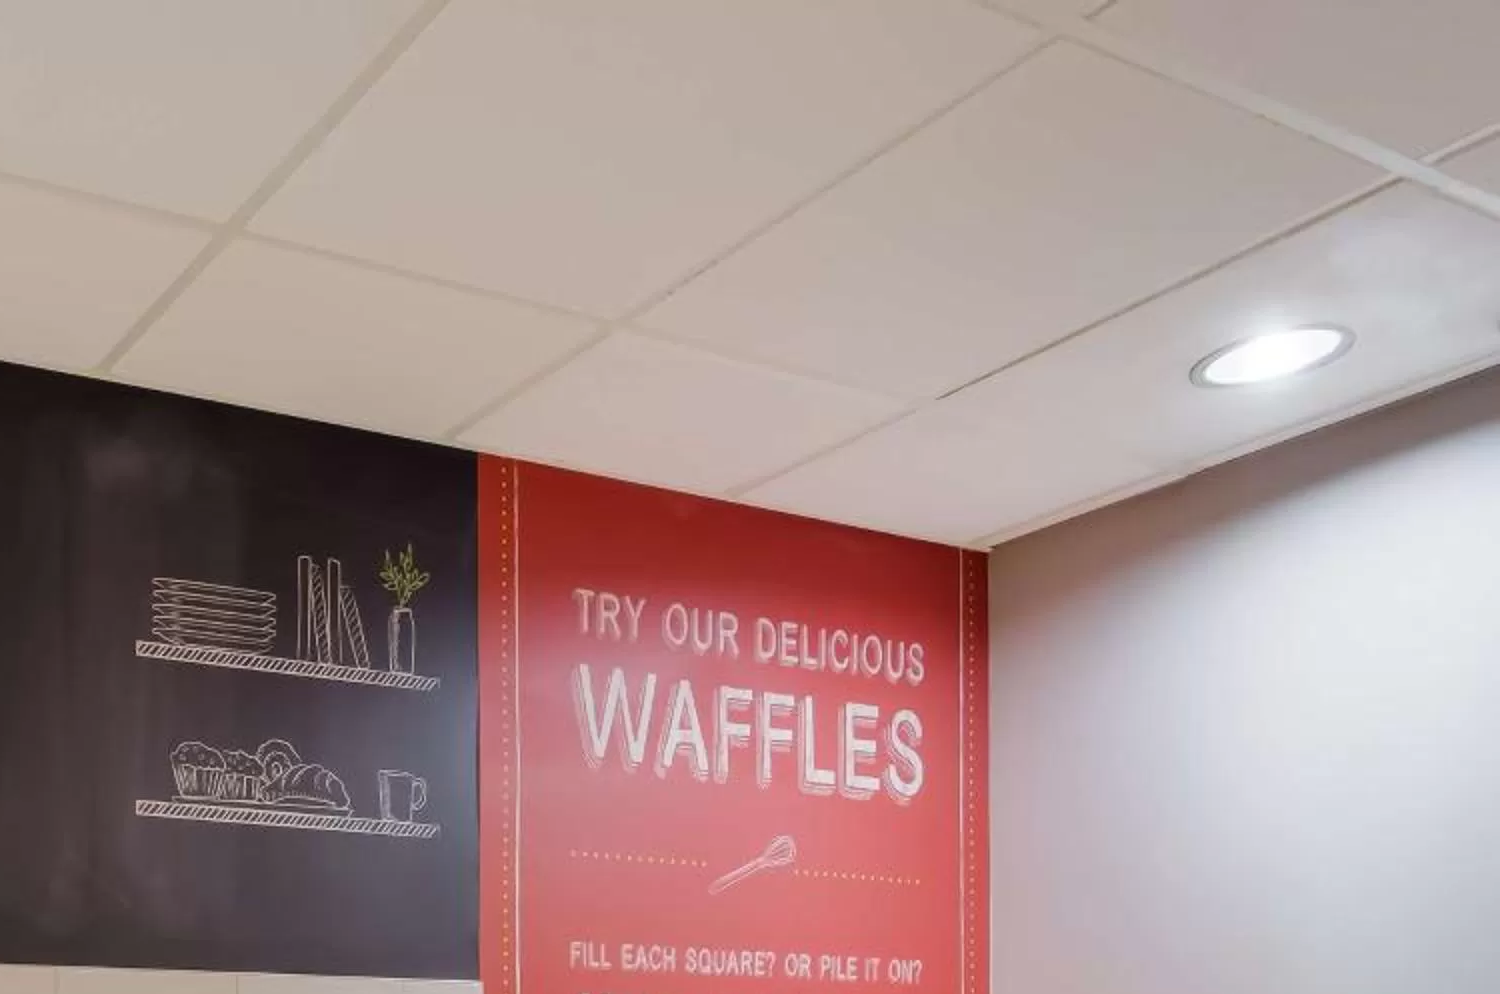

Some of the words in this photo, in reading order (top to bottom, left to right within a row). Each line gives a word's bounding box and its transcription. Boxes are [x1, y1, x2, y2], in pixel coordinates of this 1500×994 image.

[572, 587, 646, 641] TRY
[663, 603, 739, 659] OUR
[755, 617, 924, 686] DELICIOUS
[571, 663, 924, 805] WAFFLES
[569, 941, 611, 970] FILL
[621, 943, 676, 973] EACH
[684, 946, 776, 978] SQUARE?
[785, 953, 811, 980] OR
[820, 956, 857, 981] PILE
[865, 957, 880, 982] IT
[887, 959, 923, 984] ON?
